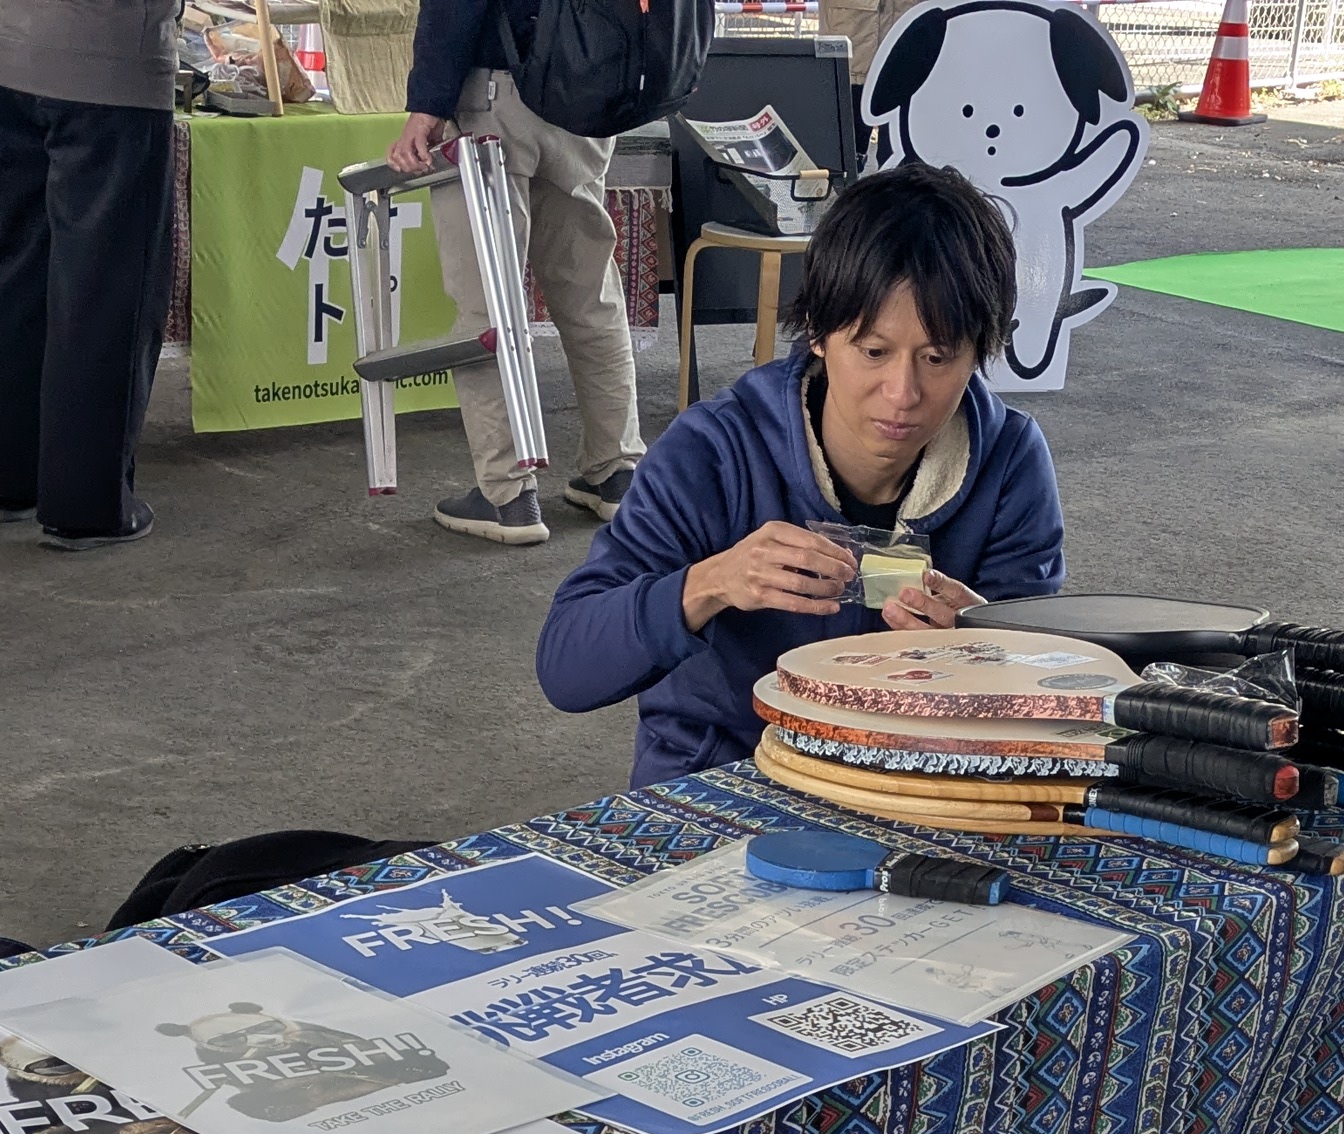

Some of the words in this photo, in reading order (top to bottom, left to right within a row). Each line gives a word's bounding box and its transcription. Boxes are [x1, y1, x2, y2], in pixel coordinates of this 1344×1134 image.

[342, 905, 584, 958] FRESH!
[663, 881, 788, 933] FRESCOB
[761, 993, 790, 1006] HP
[183, 1032, 437, 1091] FRESH!
[581, 1030, 670, 1066] Instagram
[306, 1109, 362, 1132] TAKE
[362, 1097, 408, 1118] THE
[408, 1080, 467, 1106] RALLY
